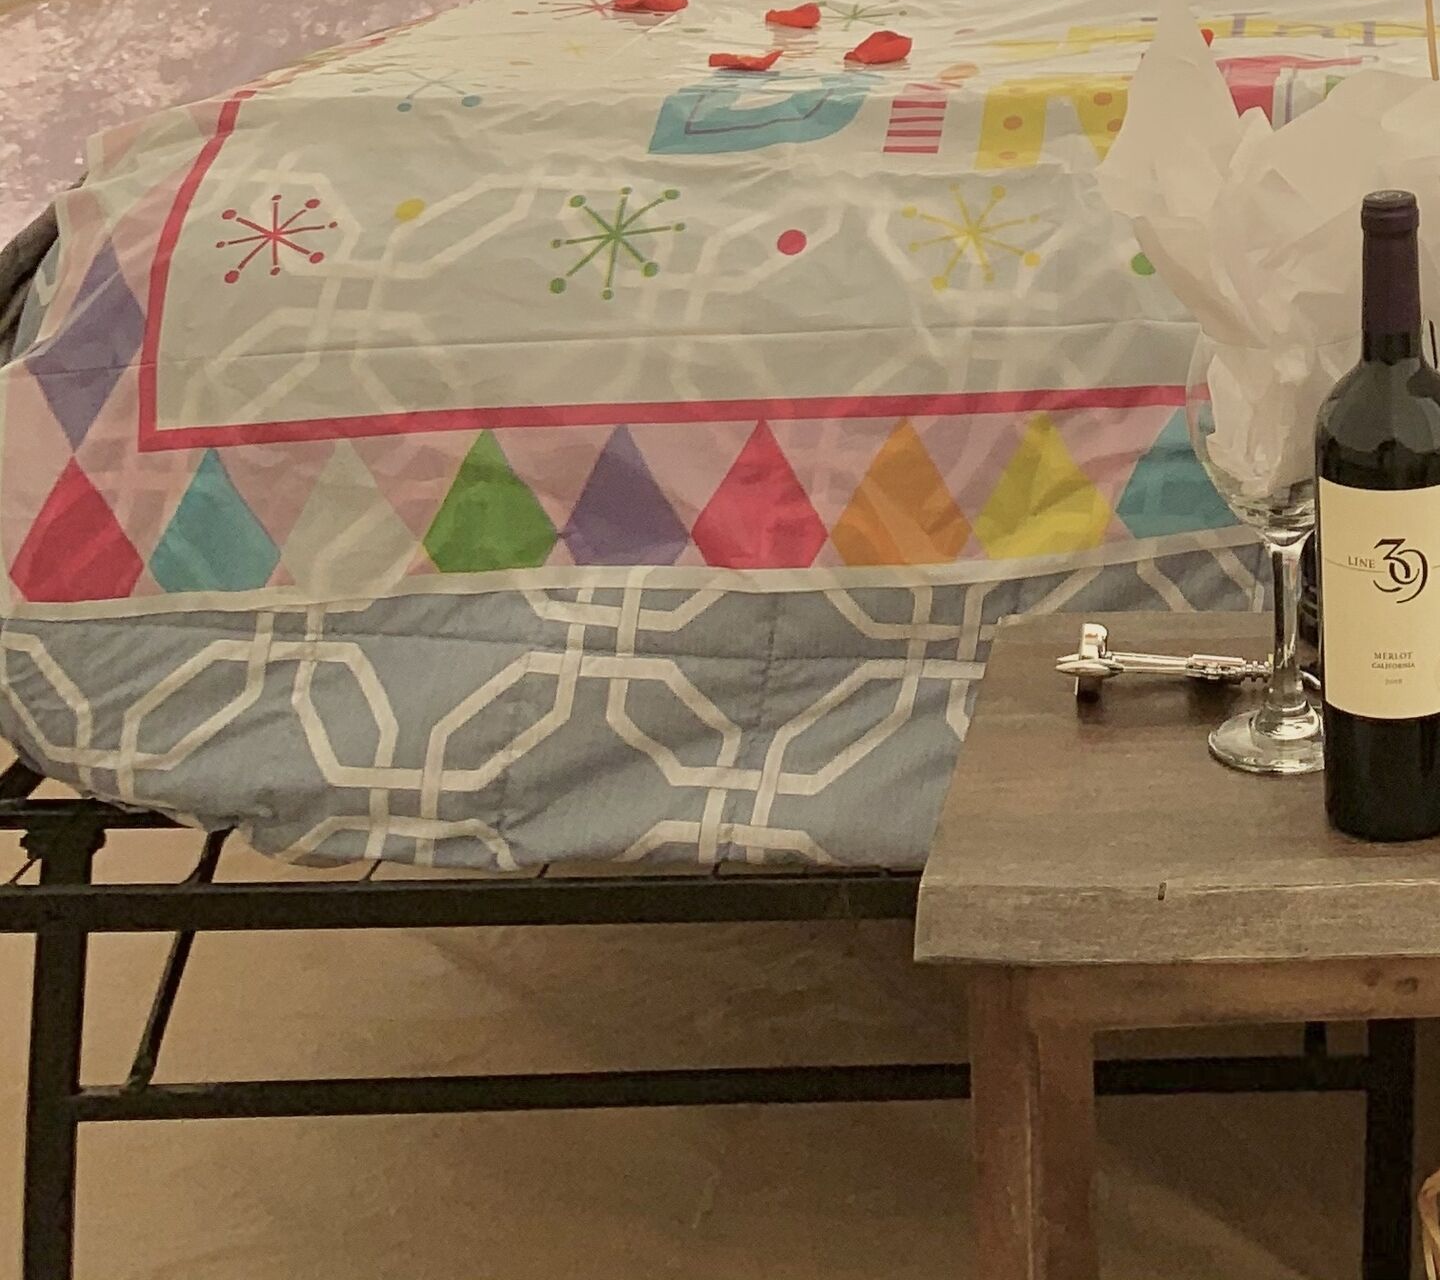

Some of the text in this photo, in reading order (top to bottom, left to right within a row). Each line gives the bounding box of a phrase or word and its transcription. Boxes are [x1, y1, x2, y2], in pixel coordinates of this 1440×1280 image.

[1347, 538, 1428, 604] LINE 39
[1373, 650, 1414, 660] MERLOT
